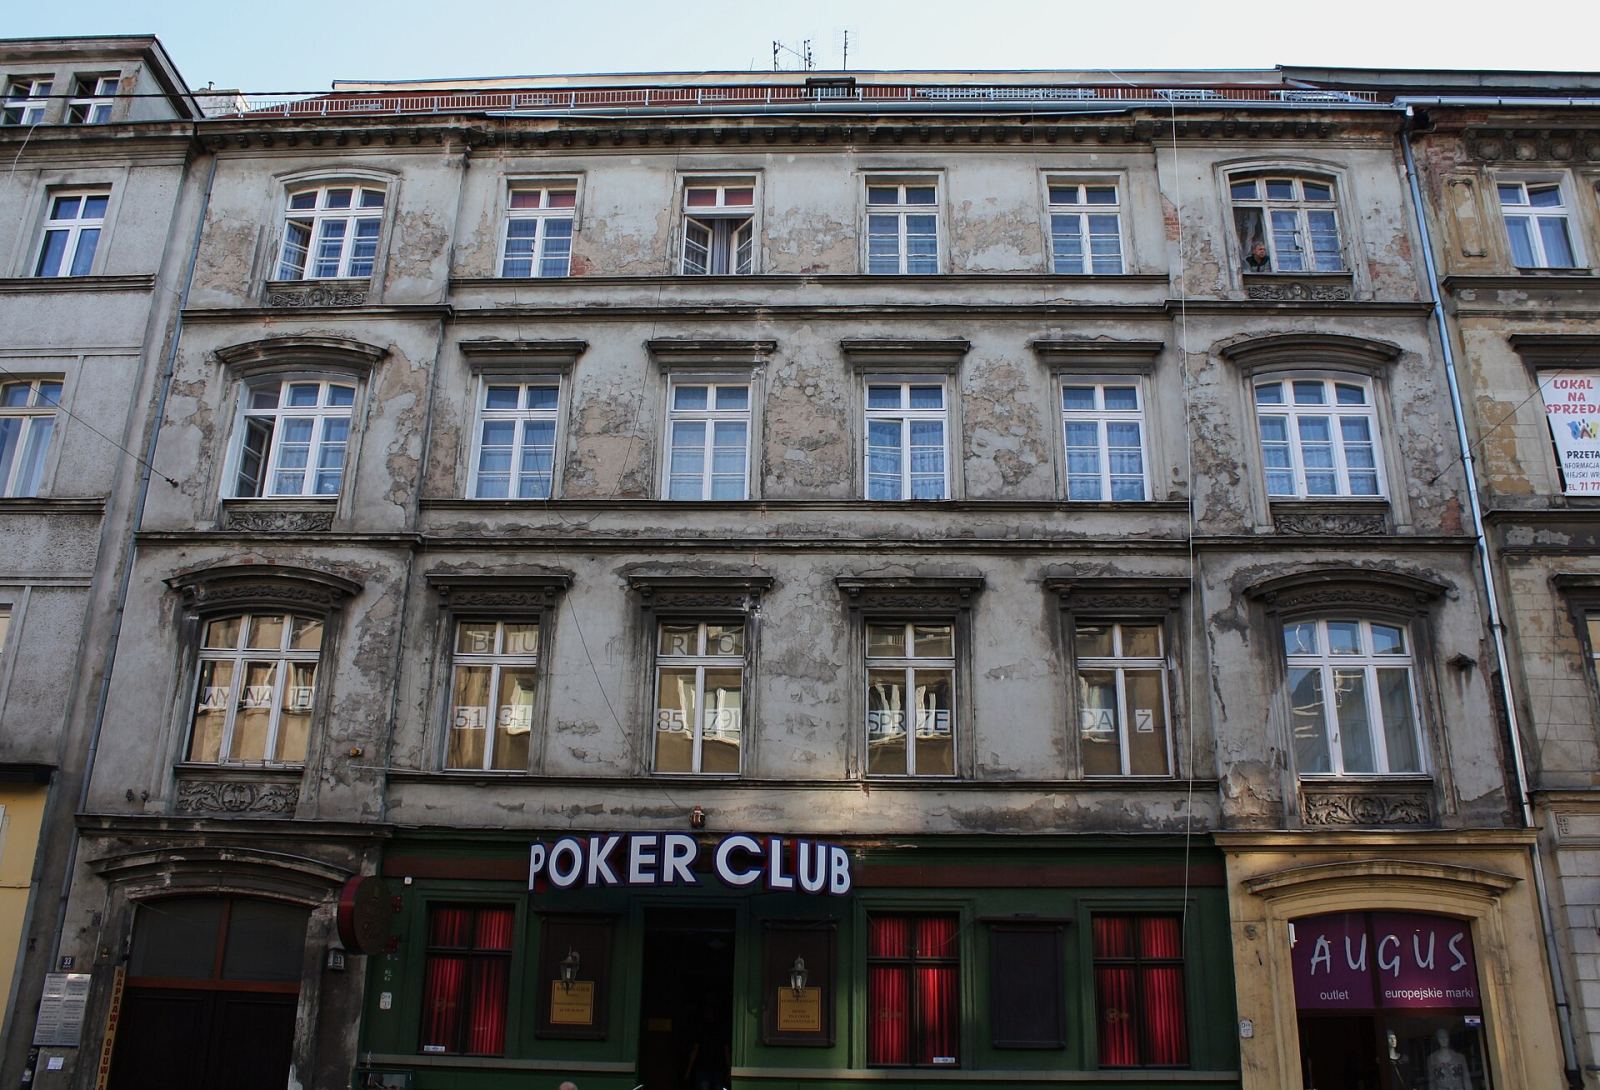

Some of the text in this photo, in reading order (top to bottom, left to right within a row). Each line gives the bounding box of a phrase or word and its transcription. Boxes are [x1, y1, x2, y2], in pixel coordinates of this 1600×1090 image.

[1553, 379, 1593, 389] LOKAL
[1568, 392, 1586, 402] NA
[1579, 482, 1588, 491] 71
[528, 834, 851, 894] POKER CLUB
[1310, 931, 1467, 977] AUGUS
[109, 970, 123, 1032] NAPRAWA
[1319, 987, 1474, 1001] outlet europejskie marki
